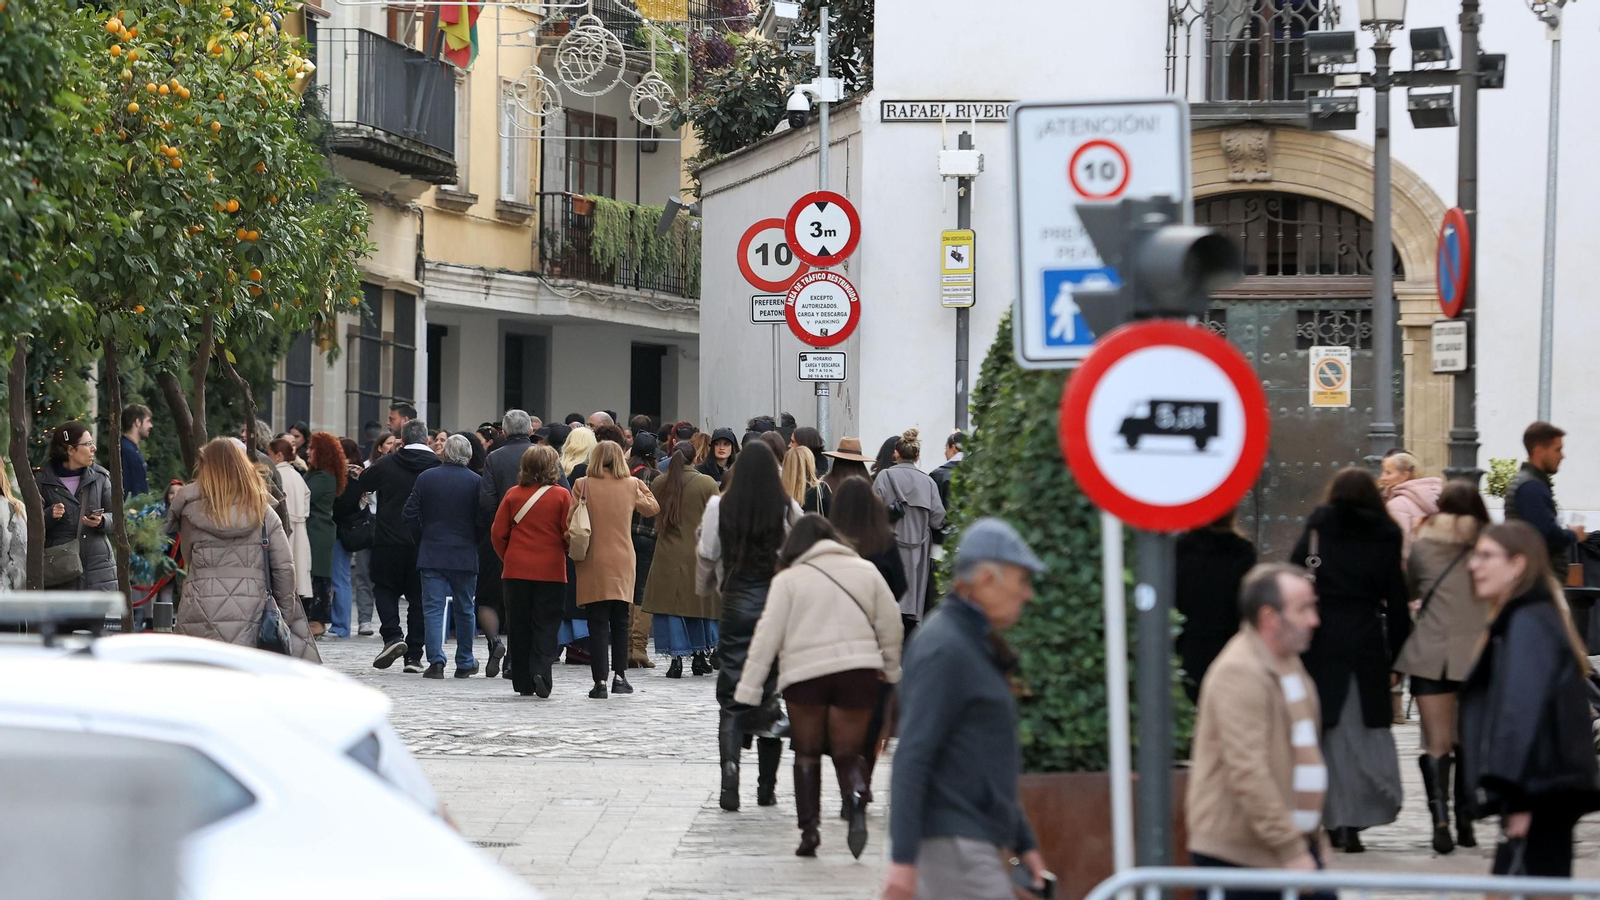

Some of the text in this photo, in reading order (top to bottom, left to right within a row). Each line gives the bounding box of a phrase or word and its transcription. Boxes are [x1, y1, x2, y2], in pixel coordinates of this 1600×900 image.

[886, 104, 950, 118] RAFAEL
[1084, 160, 1116, 181] 10
[755, 242, 793, 266] 10
[794, 282, 804, 292] DE
[800, 272, 826, 286] TRÁFICO
[826, 273, 858, 302] RESTRINGIDO
